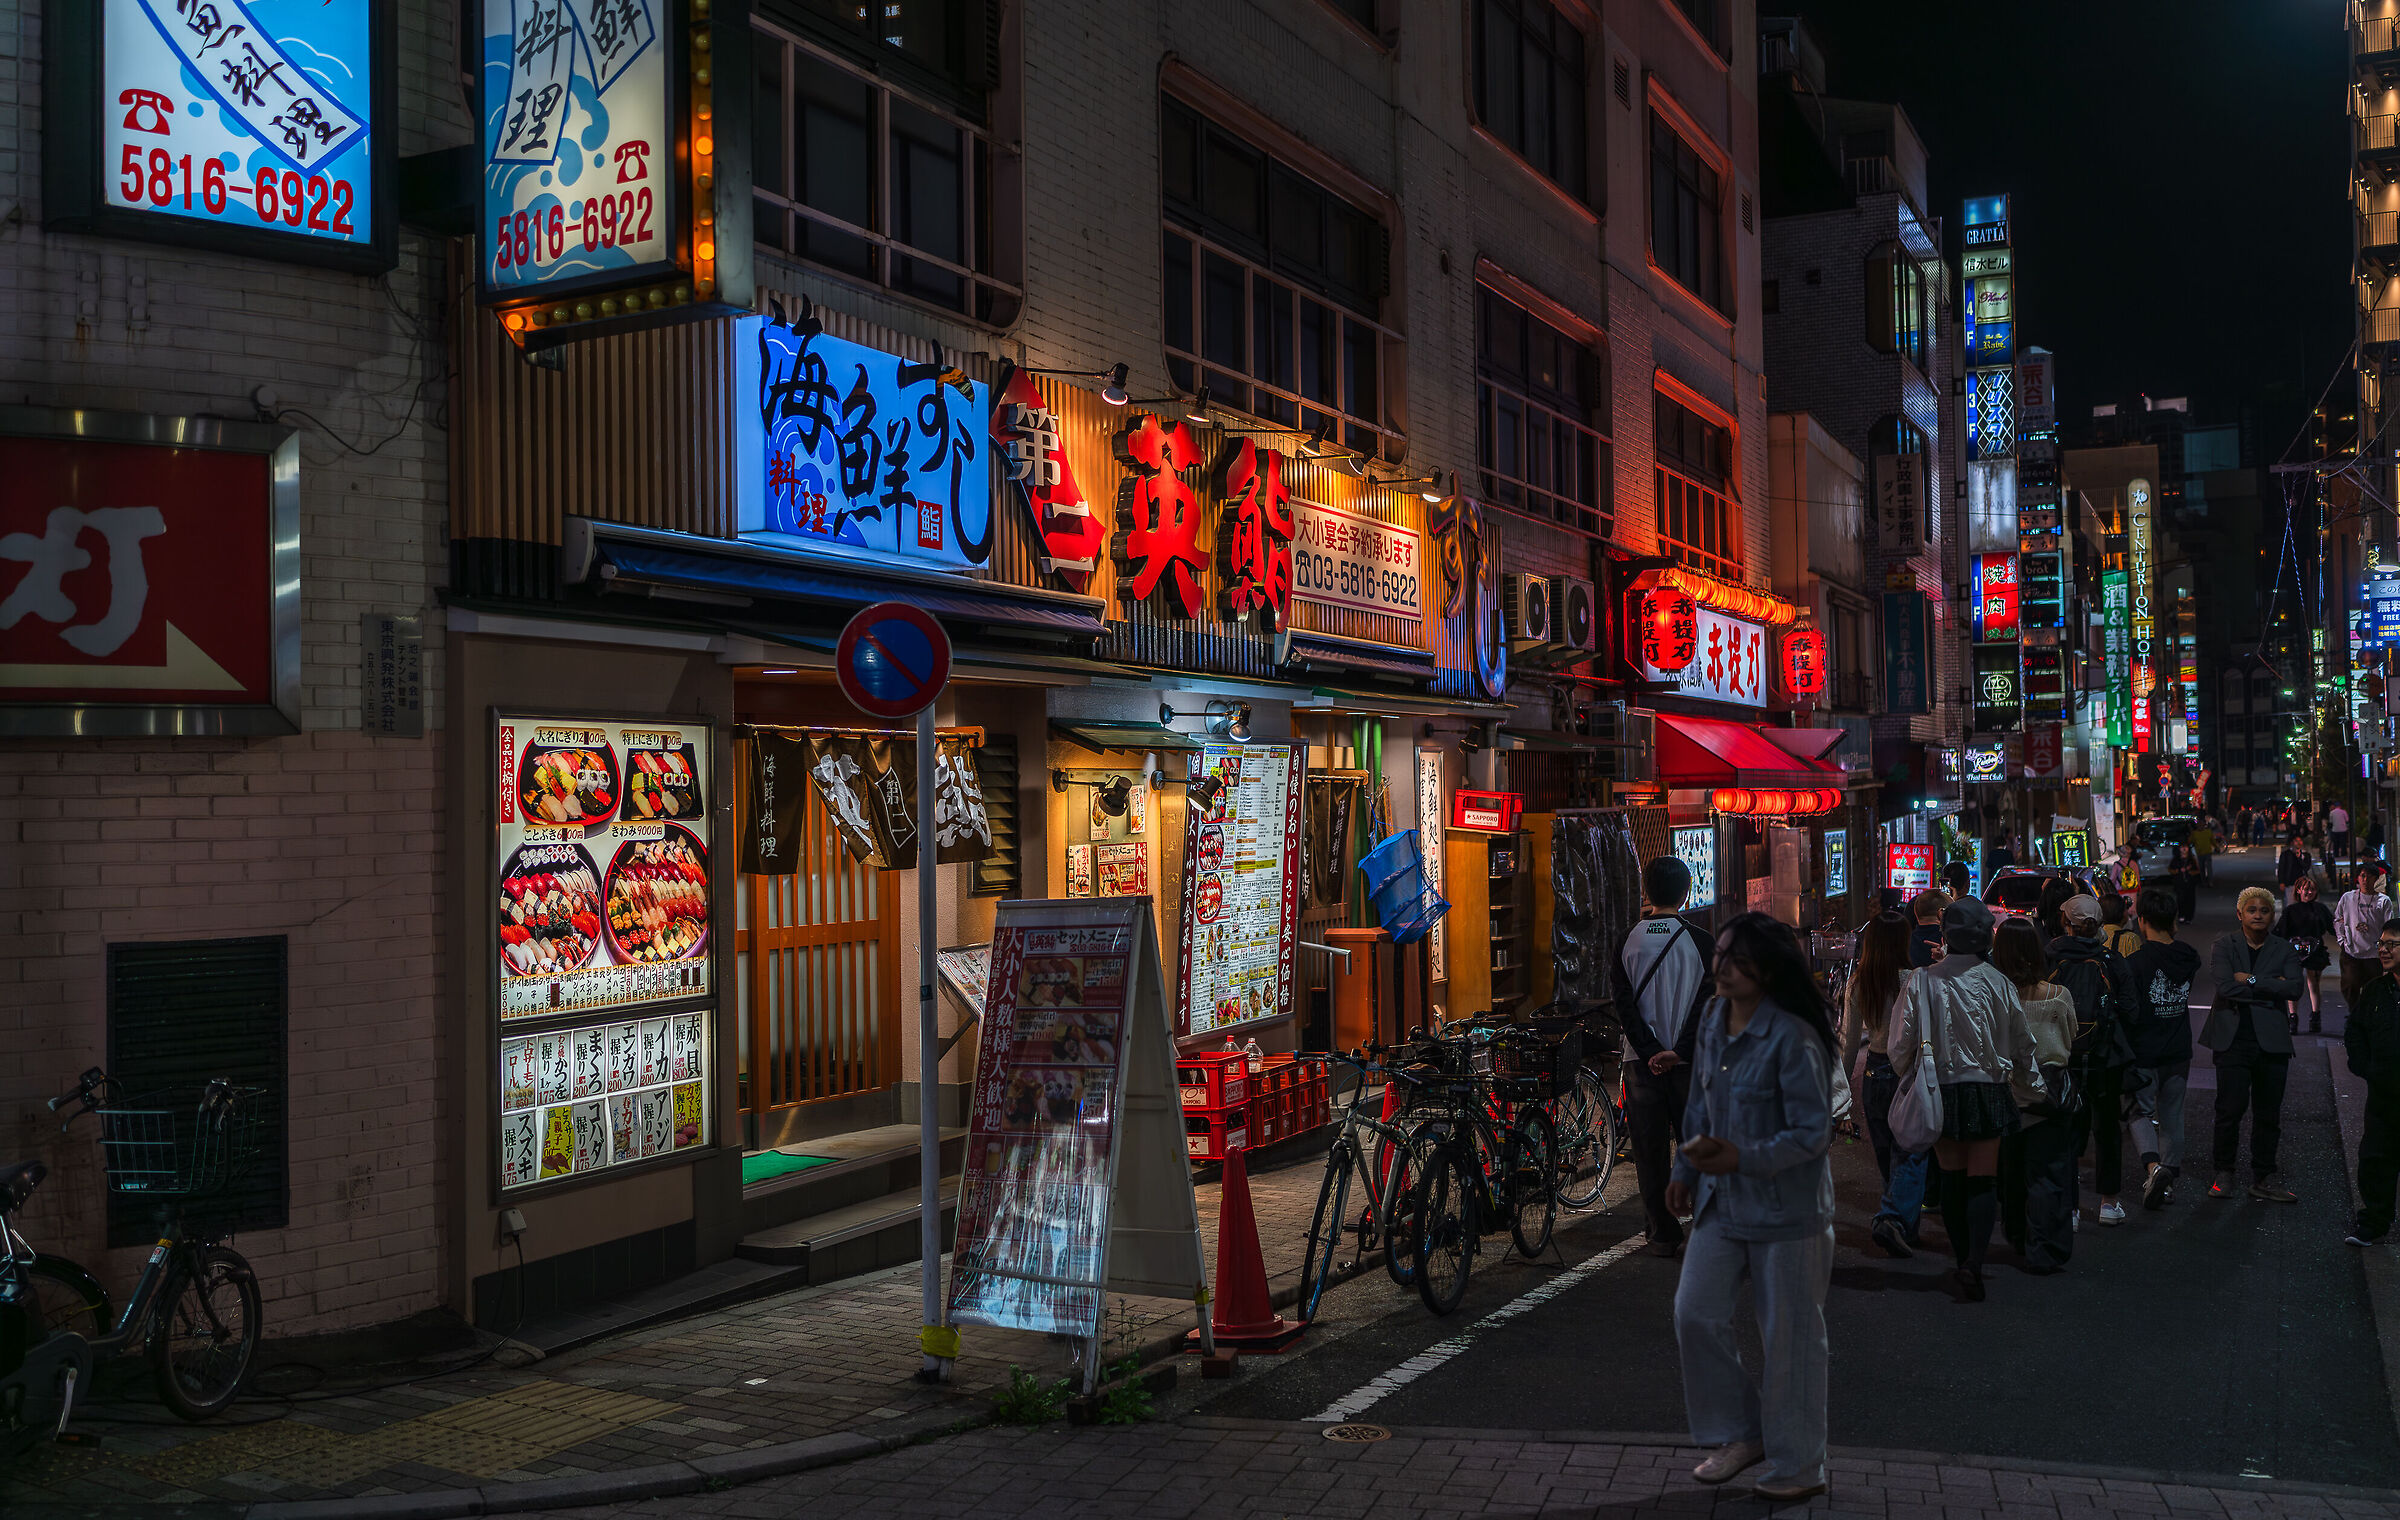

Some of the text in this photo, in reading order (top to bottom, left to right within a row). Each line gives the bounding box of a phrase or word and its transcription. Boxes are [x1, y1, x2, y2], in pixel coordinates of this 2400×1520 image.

[120, 143, 354, 235] 5816-6922
[498, 186, 653, 269] 5816-6922
[1966, 227, 2005, 244] GRATIA
[1966, 257, 2008, 272] 信水ビル
[1986, 374, 2005, 454] クリスタル
[769, 450, 828, 534] 料理
[1896, 458, 1914, 546] 行政書士事務所
[921, 504, 940, 543] 鮨
[1298, 512, 1413, 567] 大小宴会予約承ります
[1313, 553, 1417, 608] 03-5816-6922
[1984, 564, 2006, 616] 焼肉
[2132, 512, 2150, 691] CENTURION HOTEL
[1671, 598, 1695, 661] 赤提灯
[1706, 622, 1760, 701] 赤提灯
[1791, 637, 1814, 688] 赤提灯
[536, 730, 606, 744] 大名にぎり200円
[622, 732, 682, 747] 特上にぎり00円
[501, 727, 514, 817] 全品お椀付き
[760, 754, 778, 858] 海鮮料理
[1472, 814, 1498, 822] SAPPORO
[525, 828, 584, 842] ことぶき600円
[1280, 750, 1300, 1007] 自慢のおいしさと安心価格
[1057, 930, 1129, 944] セットメニュー
[644, 1033, 654, 1064] 握り
[676, 1024, 686, 1056] 握り
[686, 1016, 700, 1078] 赤貝
[983, 927, 1023, 1132] 大小人数様大歓迎
[508, 1056, 518, 1088] ロール
[523, 1040, 534, 1089] トロサーモン
[542, 1042, 552, 1076] 握り
[576, 1044, 588, 1076] 握り
[588, 1030, 604, 1094] まぐろ
[610, 1038, 621, 1070] 握り
[622, 1026, 636, 1087] エンガワ
[654, 1020, 669, 1082] イカ
[538, 1090, 555, 1106] 175
[554, 1058, 568, 1100] かつを
[574, 1085, 588, 1099] 200
[608, 1078, 622, 1092] 200
[641, 1073, 654, 1086] 200
[576, 1116, 588, 1148] 握り
[588, 1102, 604, 1167] コハダ
[644, 1104, 654, 1134] 握り
[654, 1090, 670, 1152] アジ
[504, 1128, 516, 1162] 握り
[518, 1114, 535, 1180] スズキ
[576, 1158, 590, 1172] 175
[642, 1144, 656, 1157] 200
[502, 1171, 517, 1186] 175
